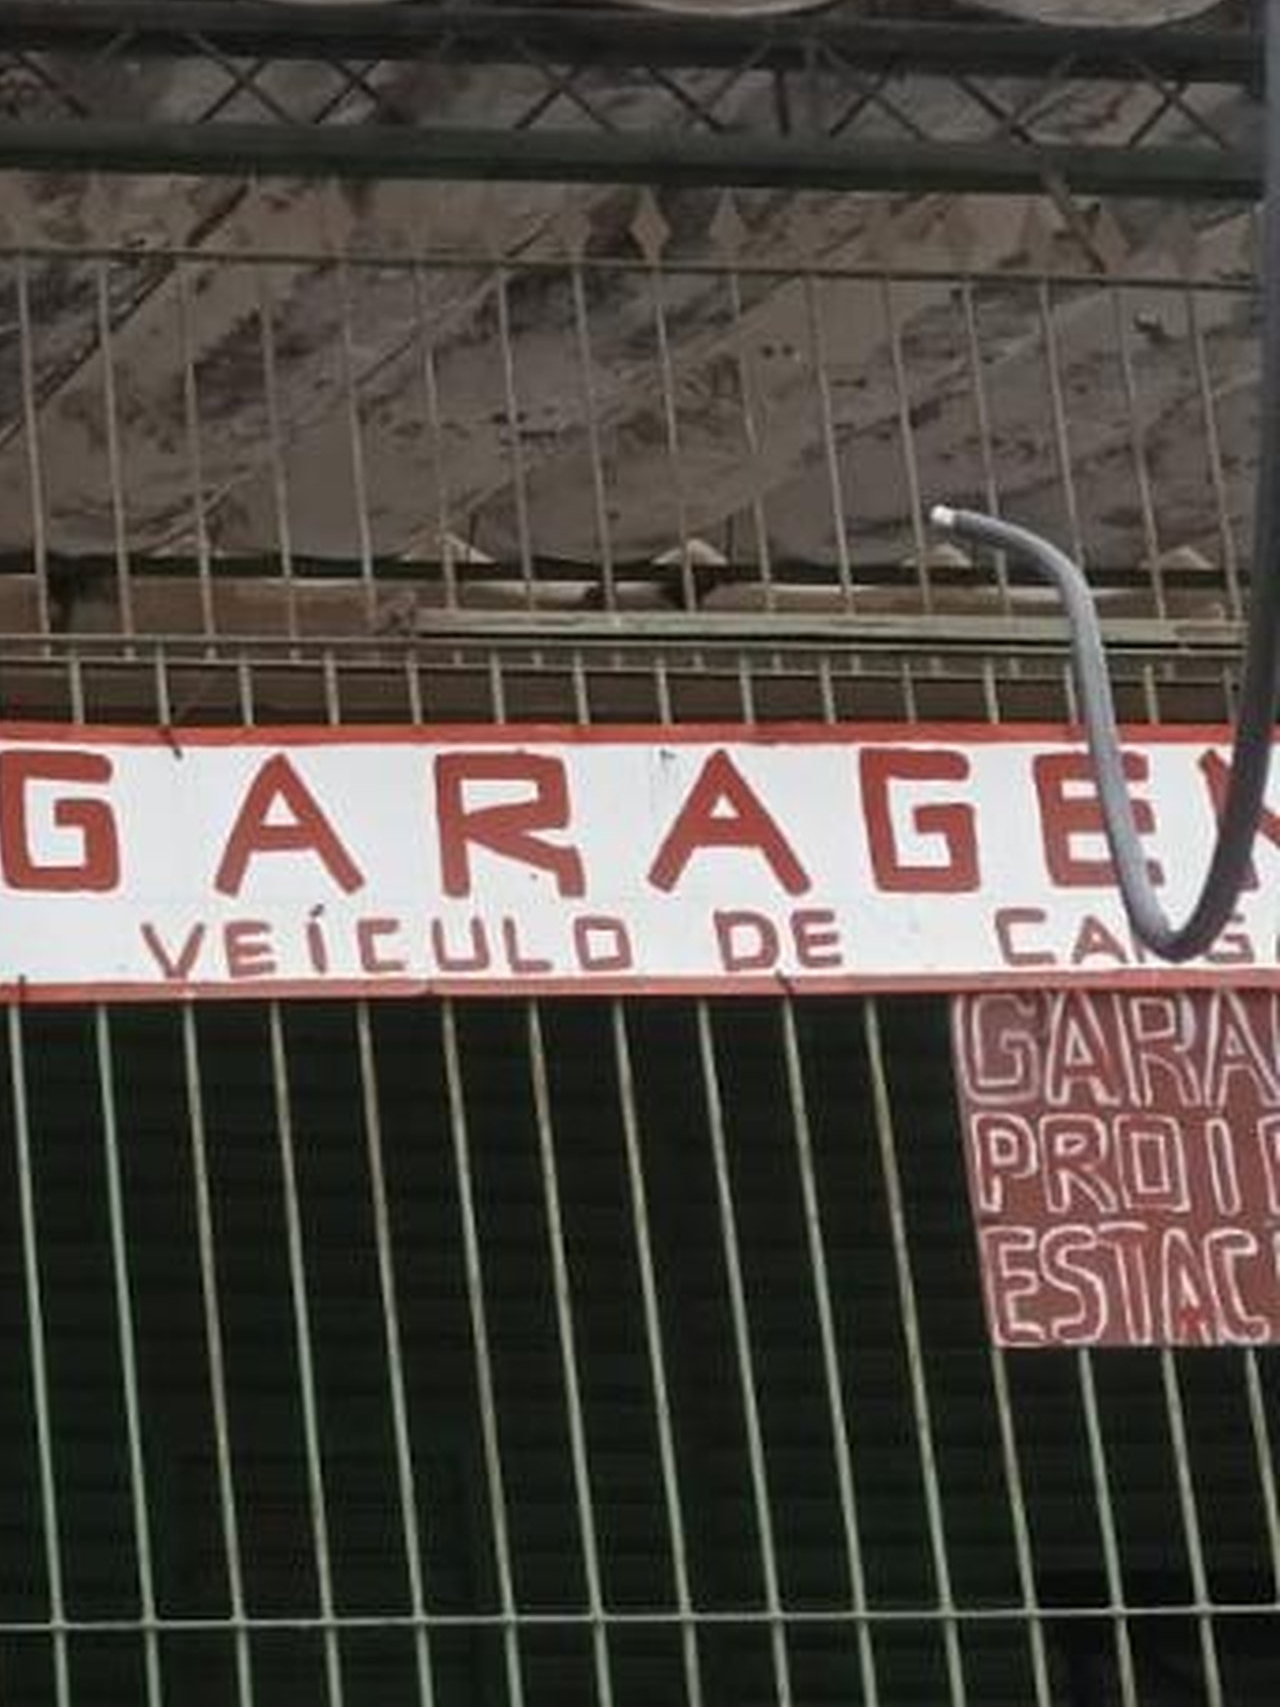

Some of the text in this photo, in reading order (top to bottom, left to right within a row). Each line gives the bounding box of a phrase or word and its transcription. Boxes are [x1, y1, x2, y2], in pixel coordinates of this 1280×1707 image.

[141, 903, 632, 980] VEÍCULO
[715, 911, 844, 972] DE
[950, 986, 1280, 1108] GARA
